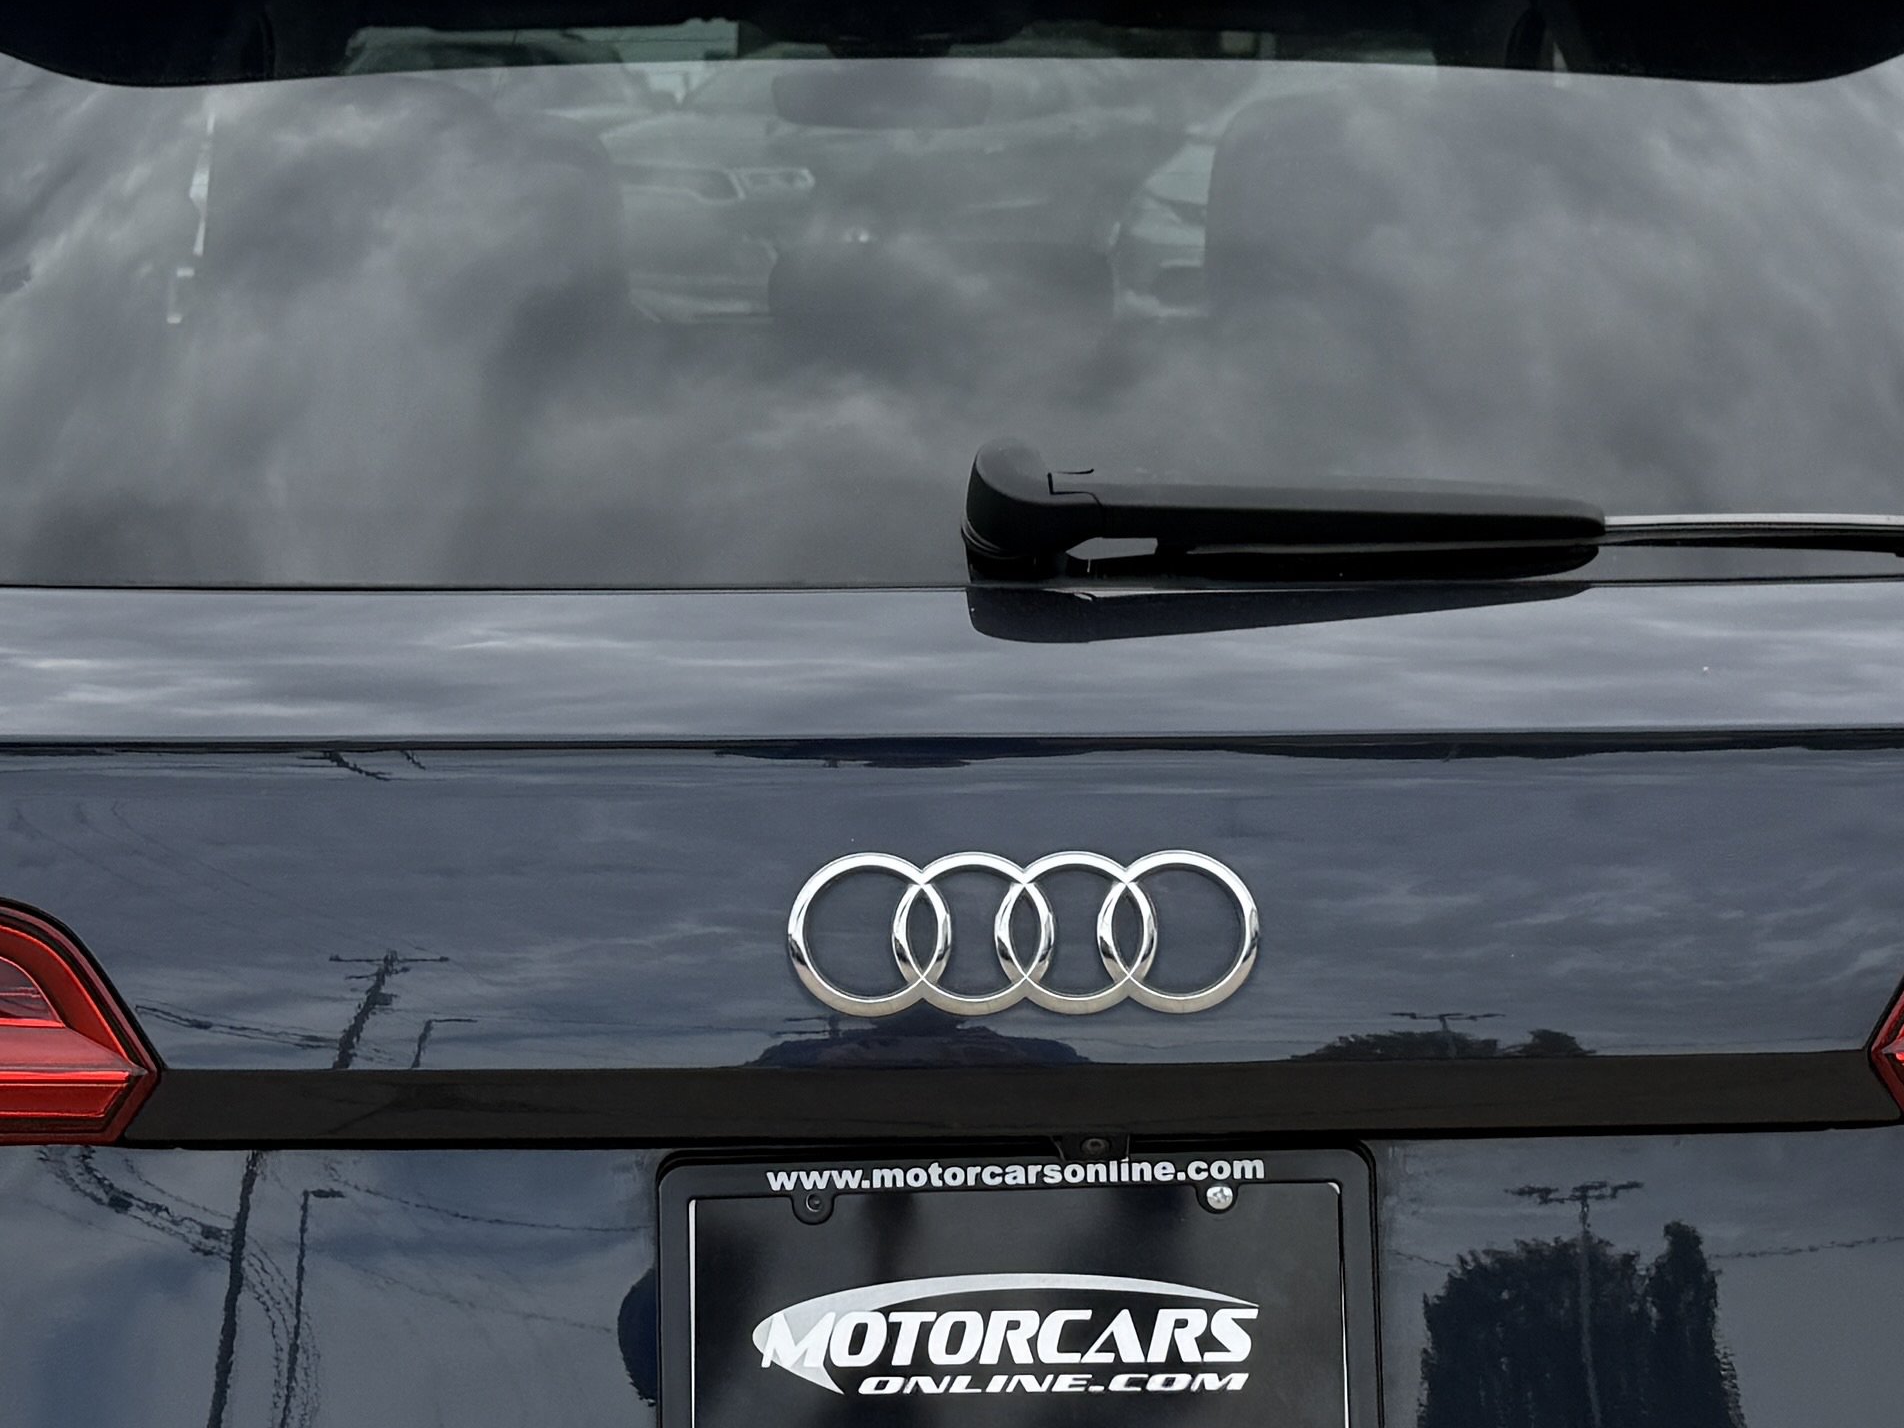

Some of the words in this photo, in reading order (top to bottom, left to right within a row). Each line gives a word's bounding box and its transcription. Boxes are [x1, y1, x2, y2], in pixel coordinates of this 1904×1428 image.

[766, 1156, 1265, 1191] www.motorcarsonline.com
[760, 1307, 1259, 1369] MOTORCARS
[857, 1371, 1249, 1395] ONLINE.COM
